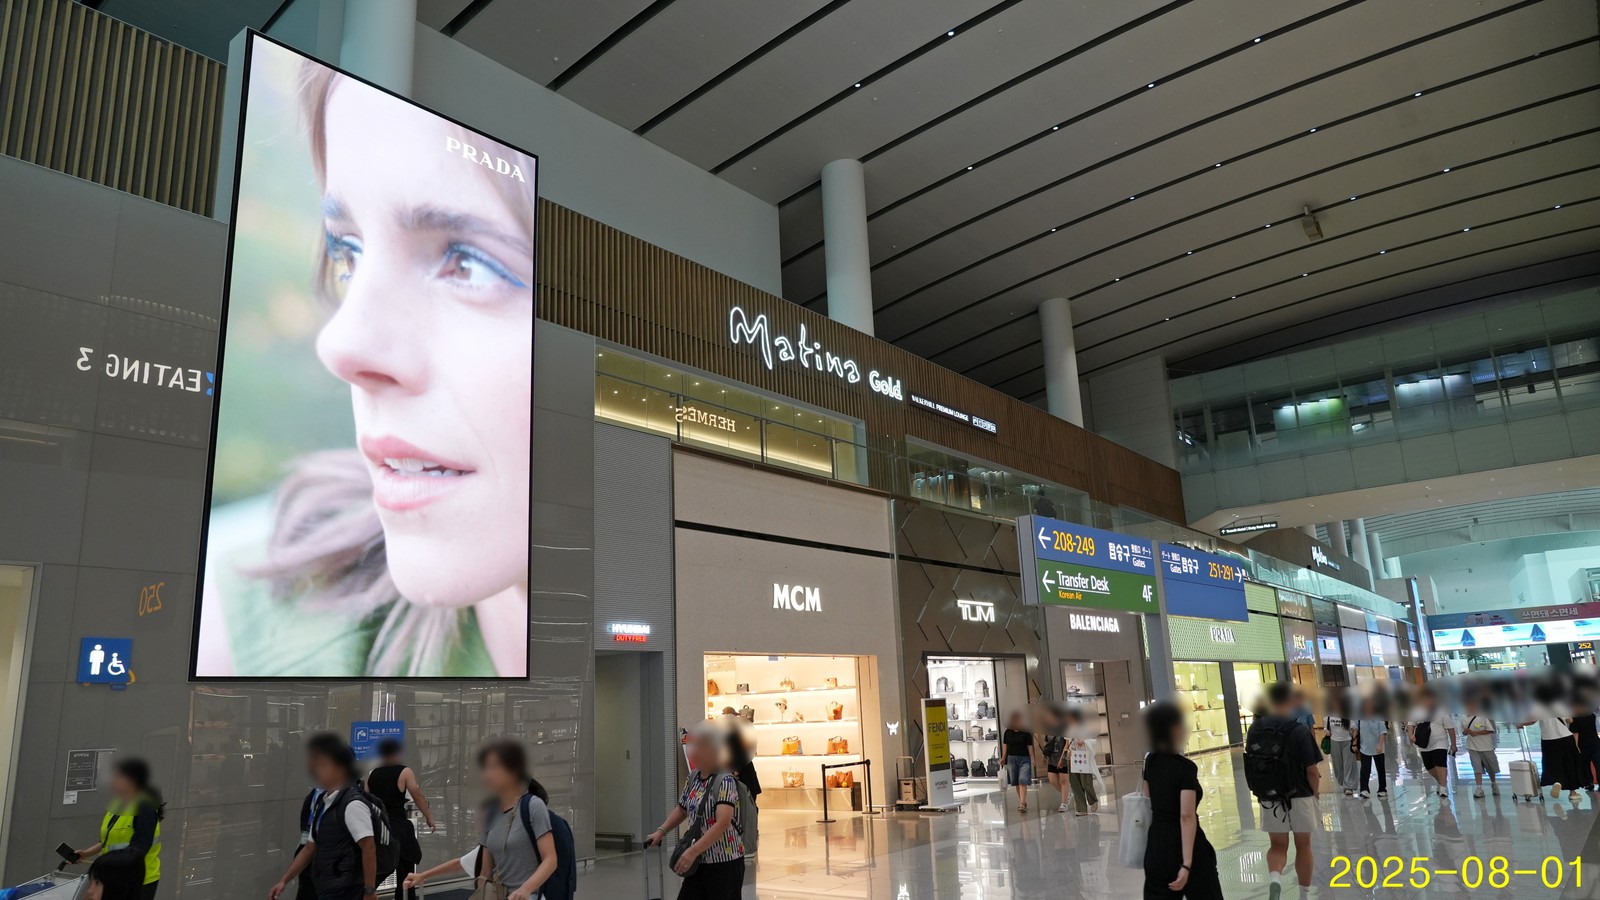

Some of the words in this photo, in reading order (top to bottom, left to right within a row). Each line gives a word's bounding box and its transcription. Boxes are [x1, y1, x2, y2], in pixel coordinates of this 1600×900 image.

[446, 136, 525, 183] PRADA
[730, 306, 860, 384] Matina
[869, 370, 903, 401] Gold
[1053, 530, 1095, 557] 208-249
[1108, 542, 1130, 562] 탑승구
[1132, 557, 1146, 568] Gates
[1169, 564, 1182, 574] Gates
[1181, 557, 1199, 575] 탑승구
[1208, 562, 1235, 581] 251-291
[1056, 570, 1090, 589] Transfer
[1090, 575, 1110, 592] Desk
[1142, 585, 1153, 602] 4F
[1058, 590, 1076, 600] Korean
[1075, 592, 1083, 600] Air
[772, 583, 822, 612] MCM
[957, 599, 995, 622] TUMI
[1069, 613, 1120, 633] BALENCIAGA
[1210, 626, 1236, 643] PRADA
[1578, 642, 1591, 650] 252
[928, 721, 946, 733] FENDI
